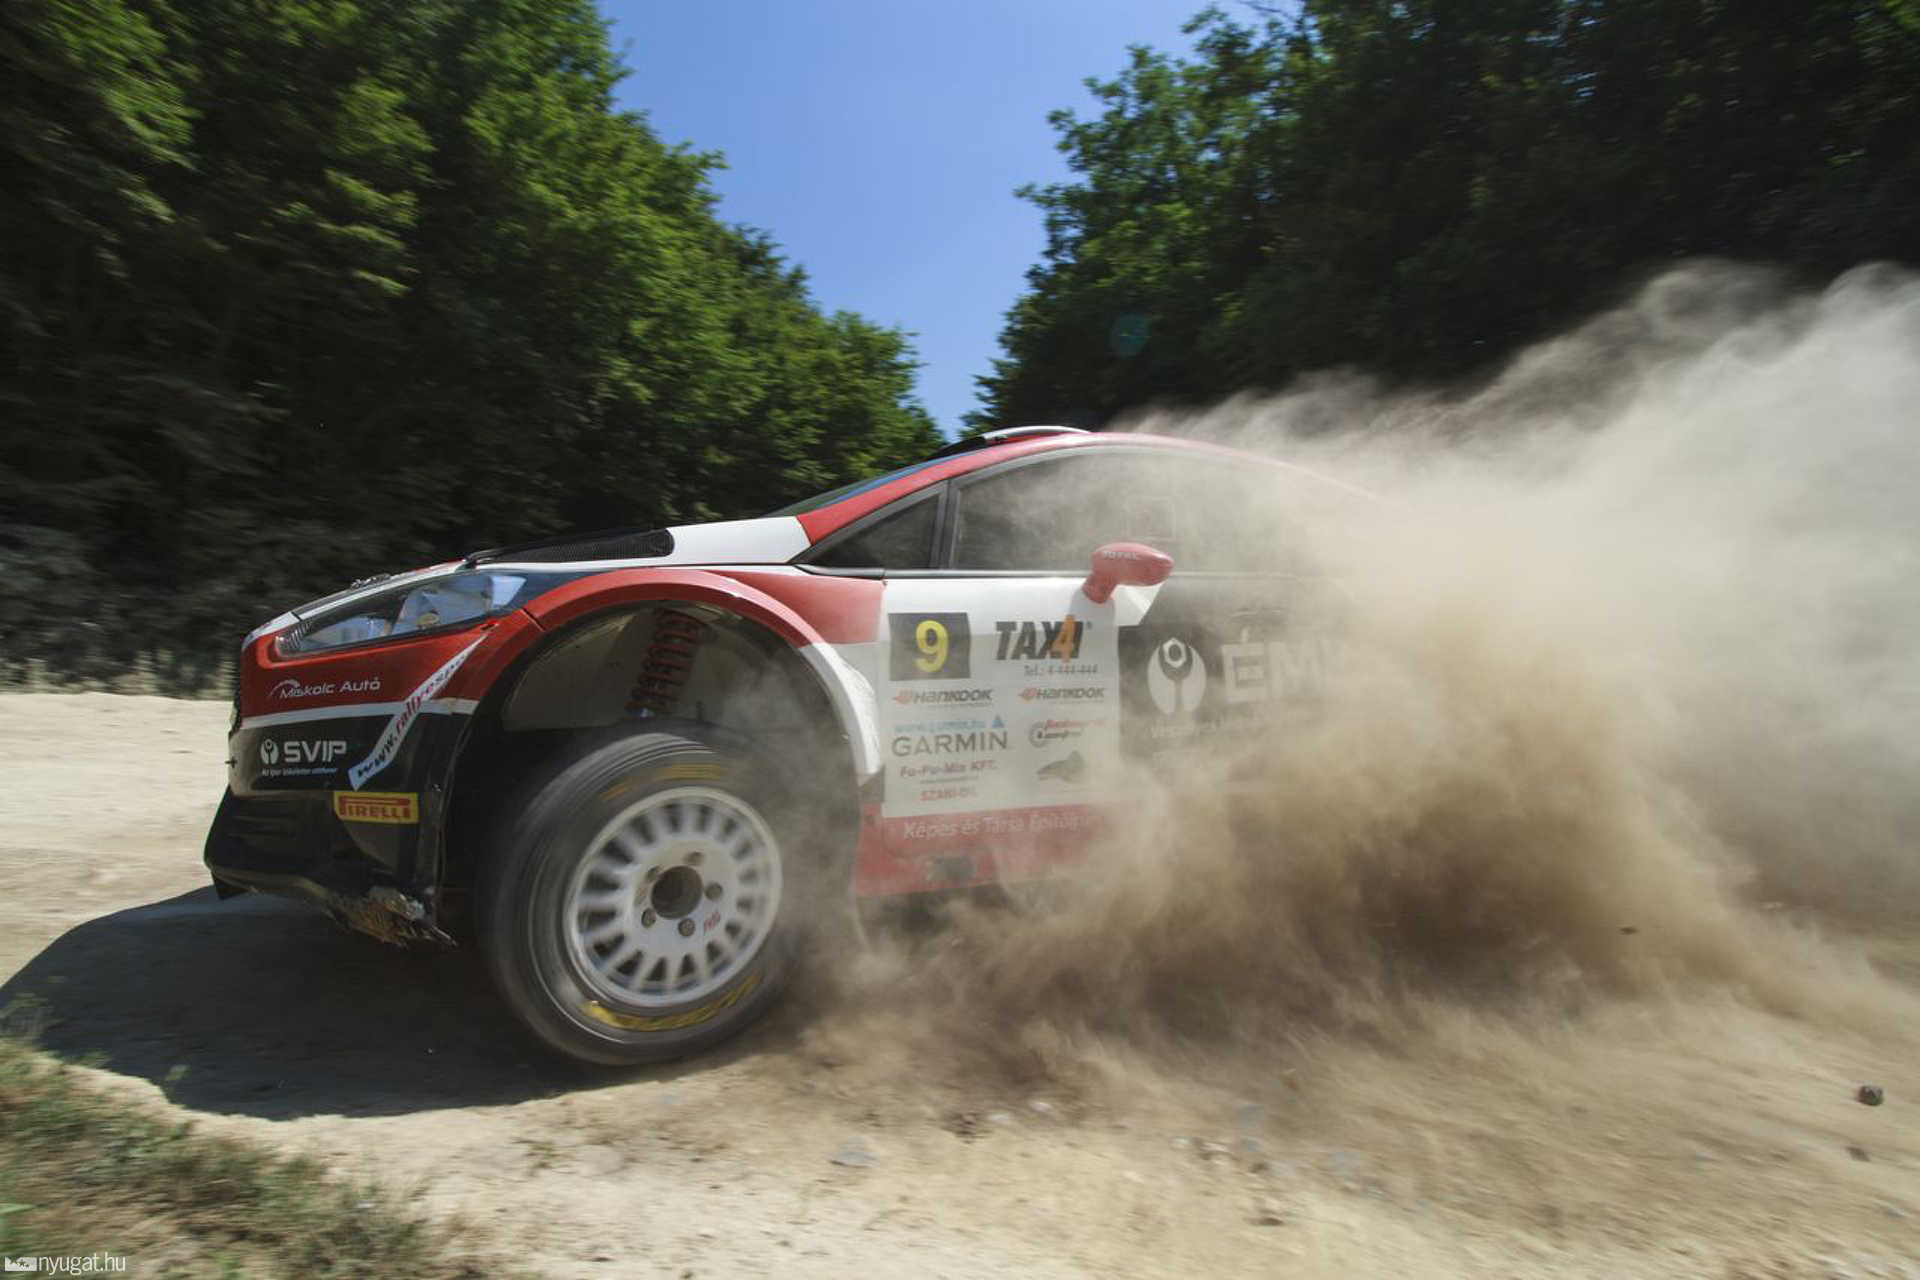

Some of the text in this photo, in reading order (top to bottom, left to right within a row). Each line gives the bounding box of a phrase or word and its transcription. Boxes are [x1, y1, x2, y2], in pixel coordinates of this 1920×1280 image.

[915, 620, 949, 673] 9
[283, 740, 347, 763] SVIP
[891, 731, 1008, 757] GARMIN
[338, 796, 411, 819] PIRELLI
